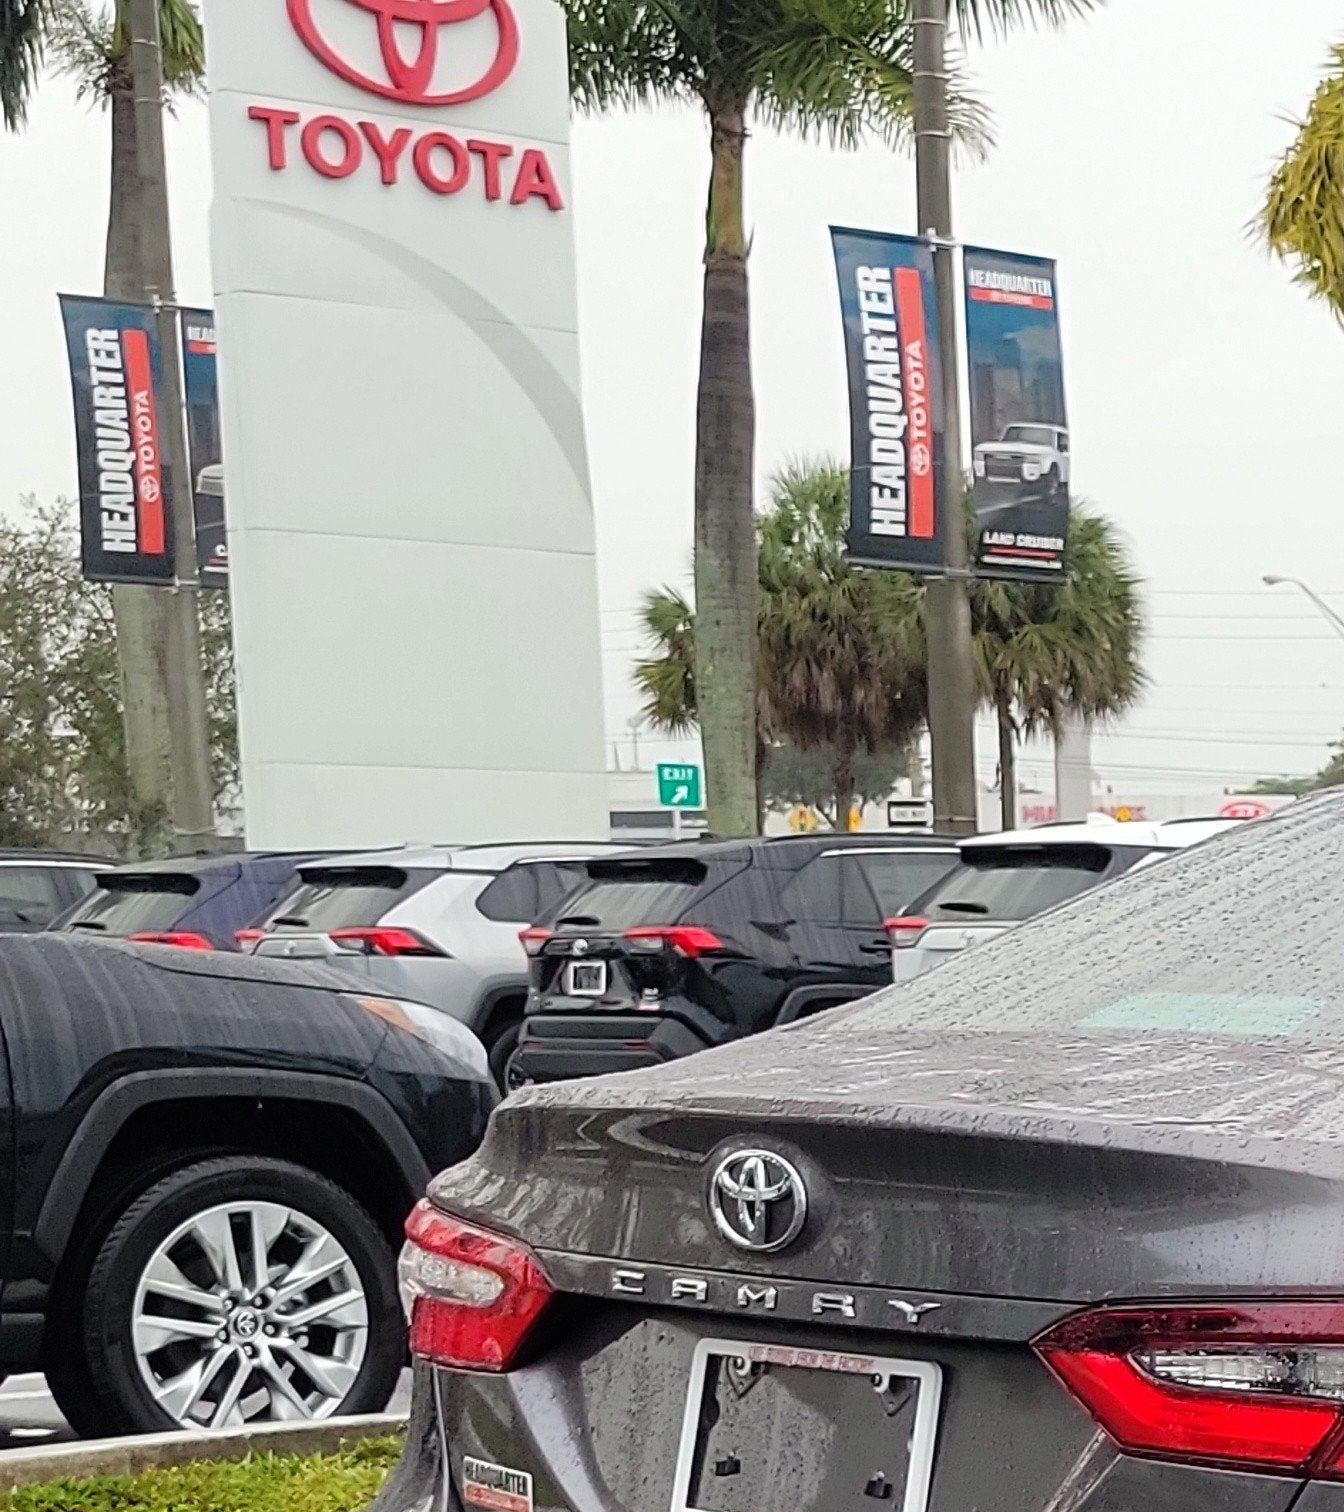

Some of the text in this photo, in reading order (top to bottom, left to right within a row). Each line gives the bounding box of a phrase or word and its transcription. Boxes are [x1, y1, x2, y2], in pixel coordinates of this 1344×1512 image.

[247, 105, 565, 211] TOYOTA
[133, 390, 156, 472] TOYOTA
[856, 265, 908, 537] HEADQUARTER
[904, 339, 928, 439] TOYOTA
[86, 328, 137, 553] HEADQUARTER
[663, 767, 693, 781] EXIT
[612, 1269, 941, 1324] CAMRY
